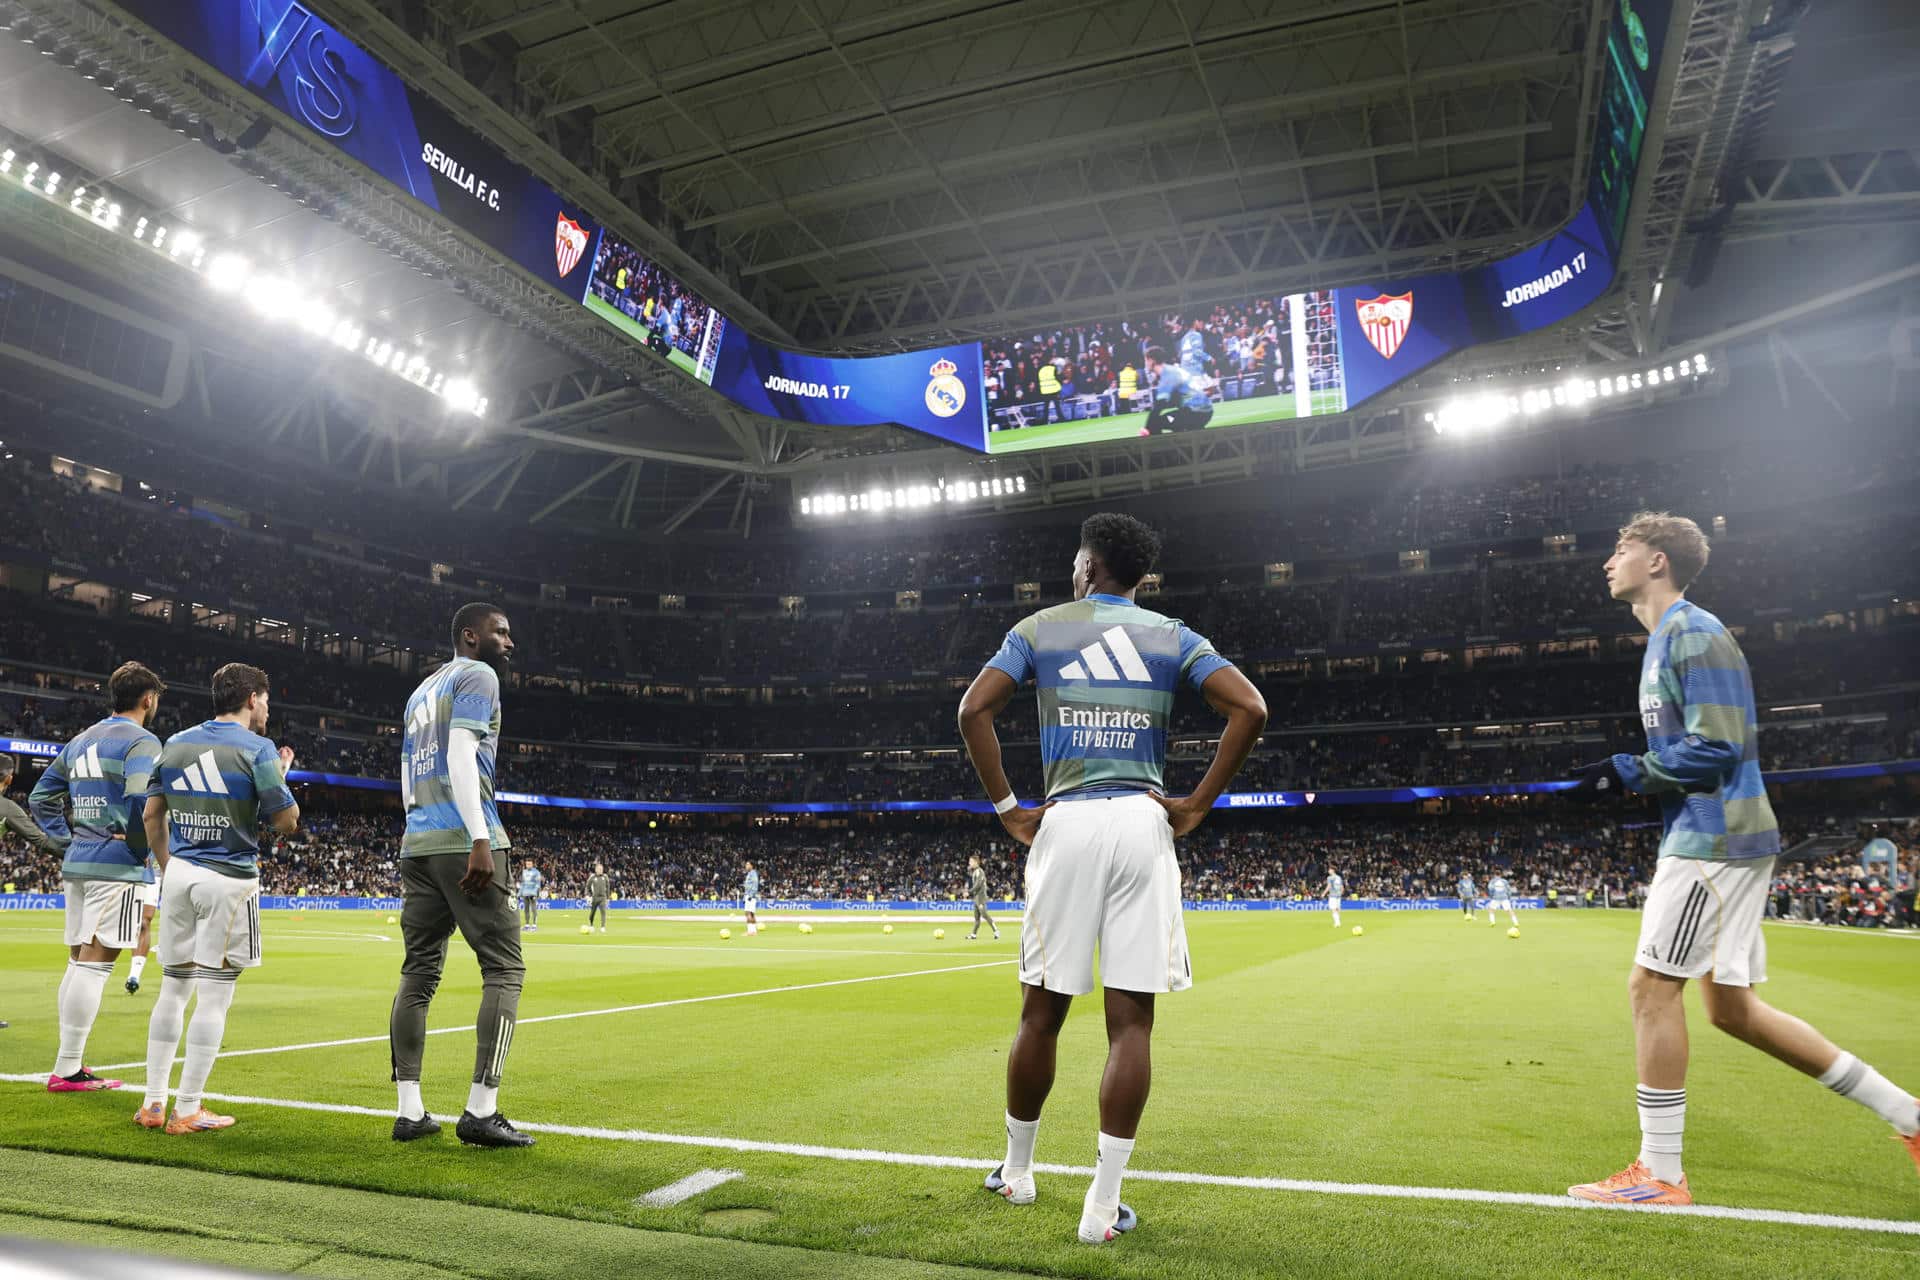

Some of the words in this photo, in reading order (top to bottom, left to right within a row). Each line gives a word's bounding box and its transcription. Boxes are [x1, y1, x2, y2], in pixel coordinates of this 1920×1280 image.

[422, 142, 475, 193] SEVILLA
[476, 180, 487, 202] F.
[488, 189, 500, 211] C.
[1502, 264, 1573, 307] JORNADA
[1572, 252, 1587, 274] 17
[765, 375, 829, 399] JORNADA
[832, 385, 850, 399] 17
[1057, 706, 1151, 730] Emirates
[1072, 730, 1092, 748] FLY
[1094, 731, 1136, 750] BETTER
[10, 741, 42, 753] SEVILLA
[1230, 795, 1266, 806] SEVILLA
[172, 809, 231, 828] Emirates
[193, 828, 222, 841] BETTER
[287, 898, 339, 910] Sanitas
[766, 901, 811, 910] Sanitas
[844, 901, 890, 910] Sanitas
[1193, 901, 1248, 911] Sanitas
[1380, 901, 1440, 911] Sanitas
